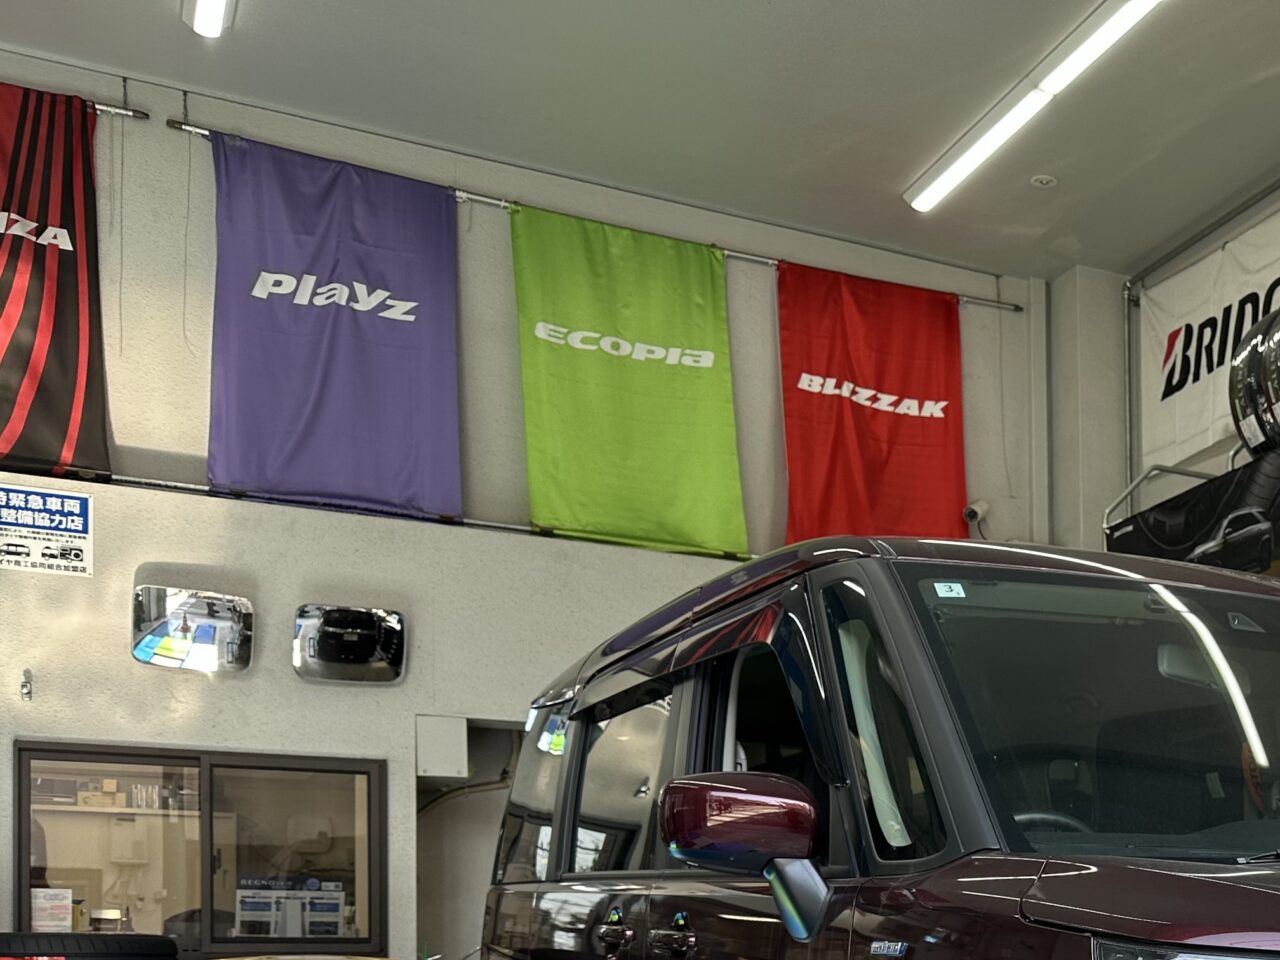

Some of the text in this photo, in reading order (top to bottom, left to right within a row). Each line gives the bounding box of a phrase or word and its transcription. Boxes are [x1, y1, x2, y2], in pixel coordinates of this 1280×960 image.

[251, 271, 419, 322] Playz
[797, 372, 949, 418] BLIZZAK
[943, 584, 954, 593] 3
